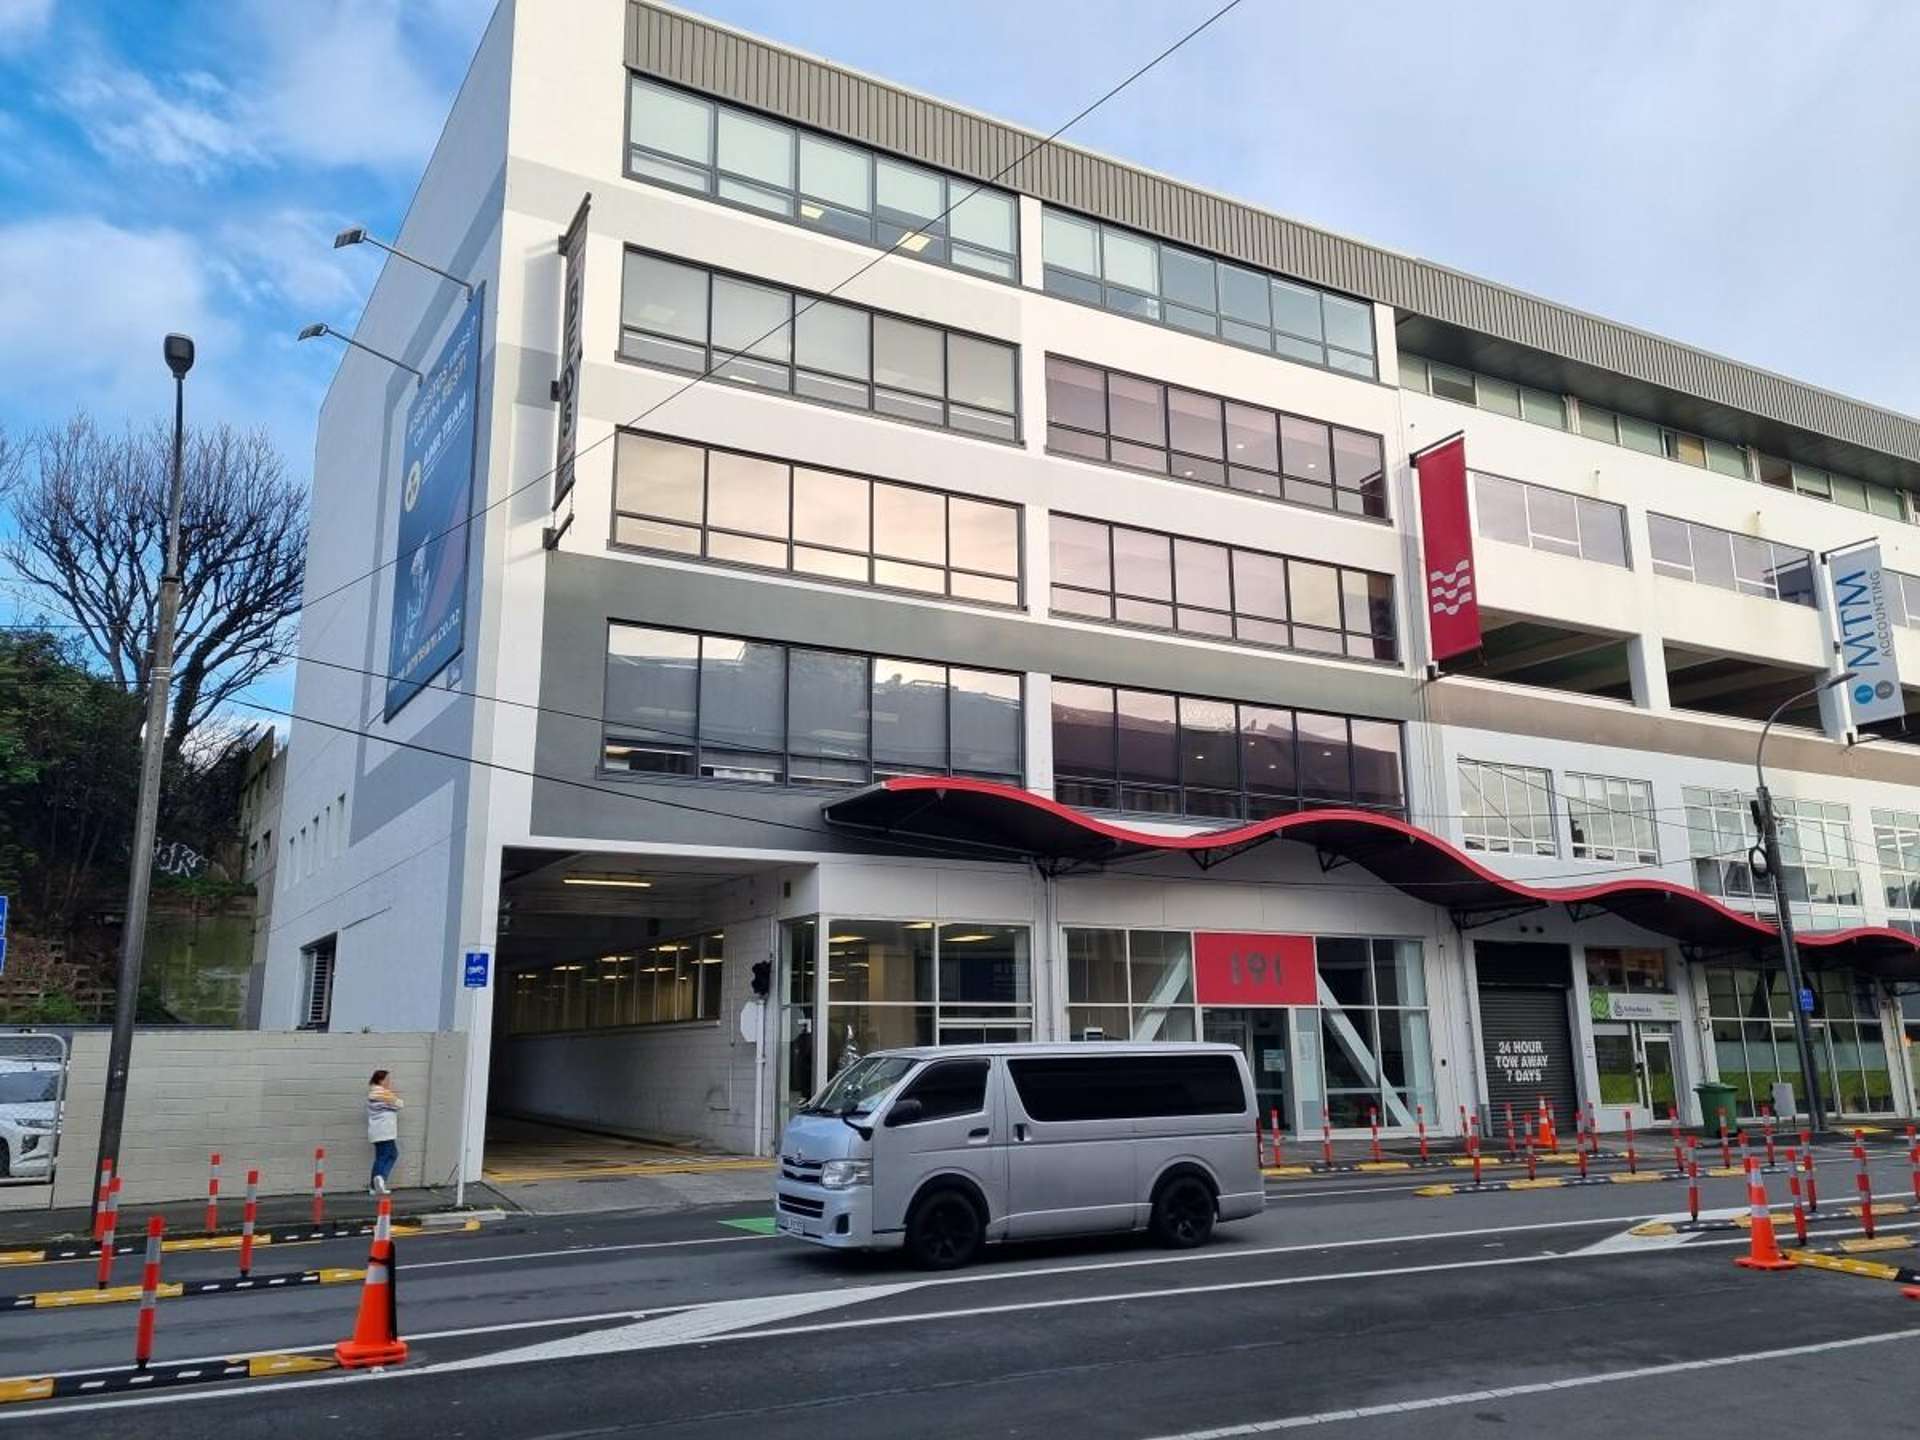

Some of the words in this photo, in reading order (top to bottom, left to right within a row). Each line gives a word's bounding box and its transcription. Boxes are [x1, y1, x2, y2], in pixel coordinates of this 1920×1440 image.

[1836, 570, 1880, 668] MTM
[1870, 570, 1893, 657] ACCOUNTING
[1499, 1041, 1511, 1053] 24
[1513, 1040, 1543, 1053] HOUR
[1495, 1055, 1519, 1068] TOW
[1521, 1055, 1548, 1067] AWAY
[1506, 1069, 1513, 1082] 7
[1515, 1068, 1541, 1082] DAYS
